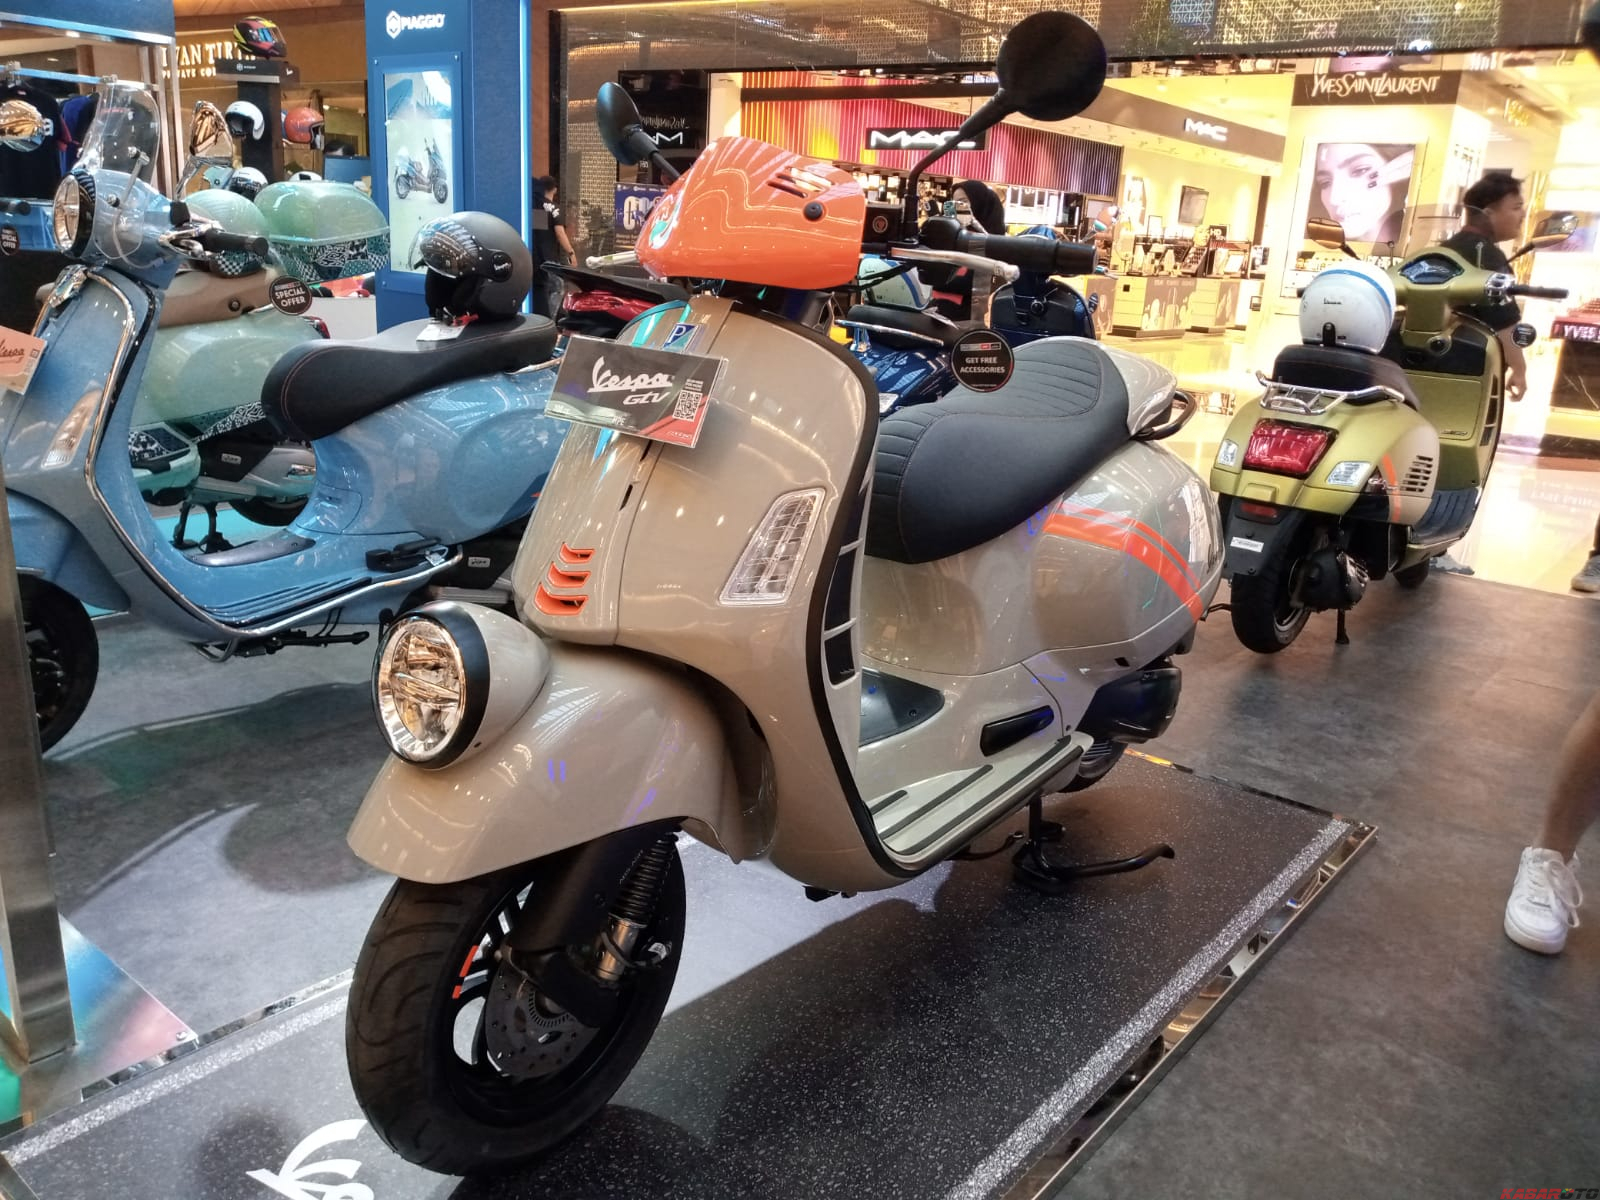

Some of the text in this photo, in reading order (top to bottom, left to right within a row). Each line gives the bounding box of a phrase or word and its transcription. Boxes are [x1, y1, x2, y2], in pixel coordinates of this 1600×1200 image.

[401, 14, 446, 30] PIAGGIO
[275, 287, 306, 299] SPECIAL
[280, 296, 306, 307] OFFER
[980, 356, 998, 364] FREE
[587, 356, 673, 393] Vespa
[960, 366, 1006, 374] ACCESSORIES
